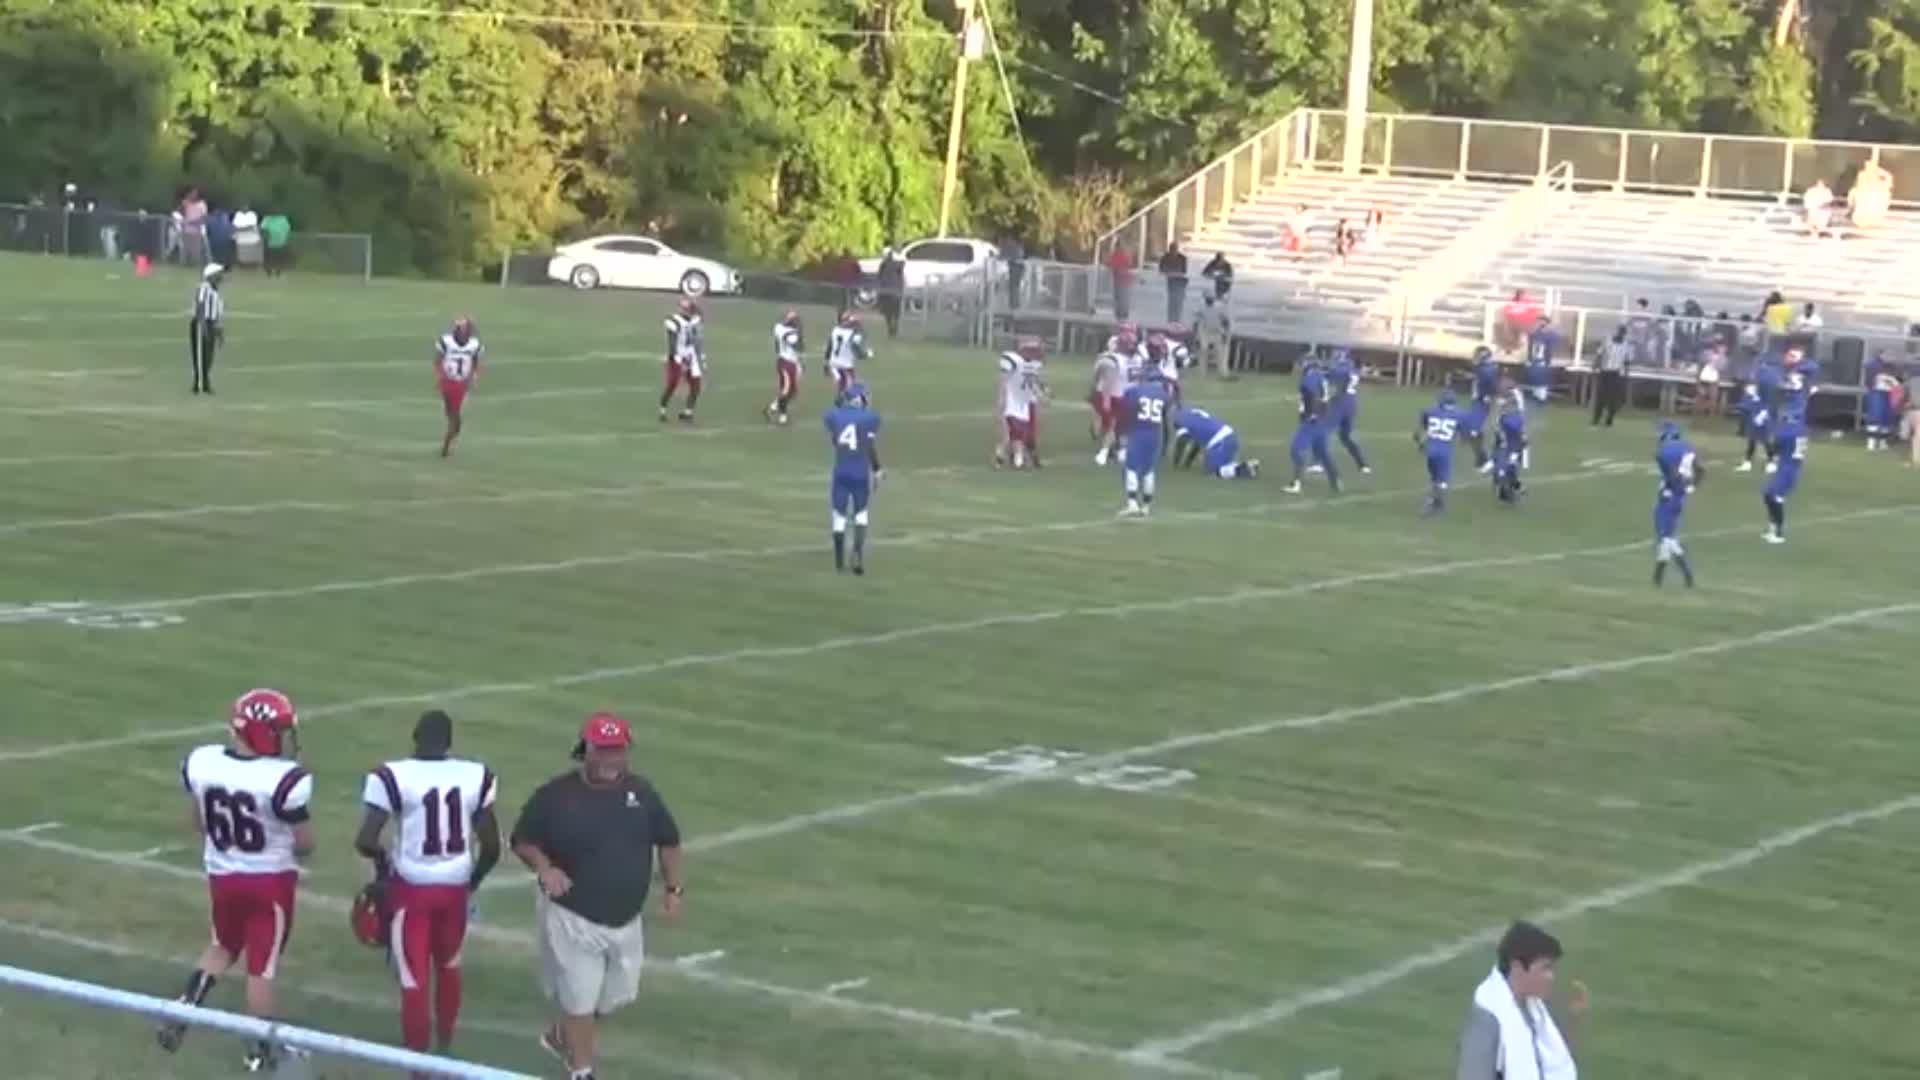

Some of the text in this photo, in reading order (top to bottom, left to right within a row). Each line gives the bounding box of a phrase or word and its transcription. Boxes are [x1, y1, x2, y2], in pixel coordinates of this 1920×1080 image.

[1136, 397, 1165, 423] 35
[838, 423, 858, 450] 4
[1427, 417, 1458, 441] 25
[203, 786, 266, 852] 66
[422, 786, 466, 856] 11
